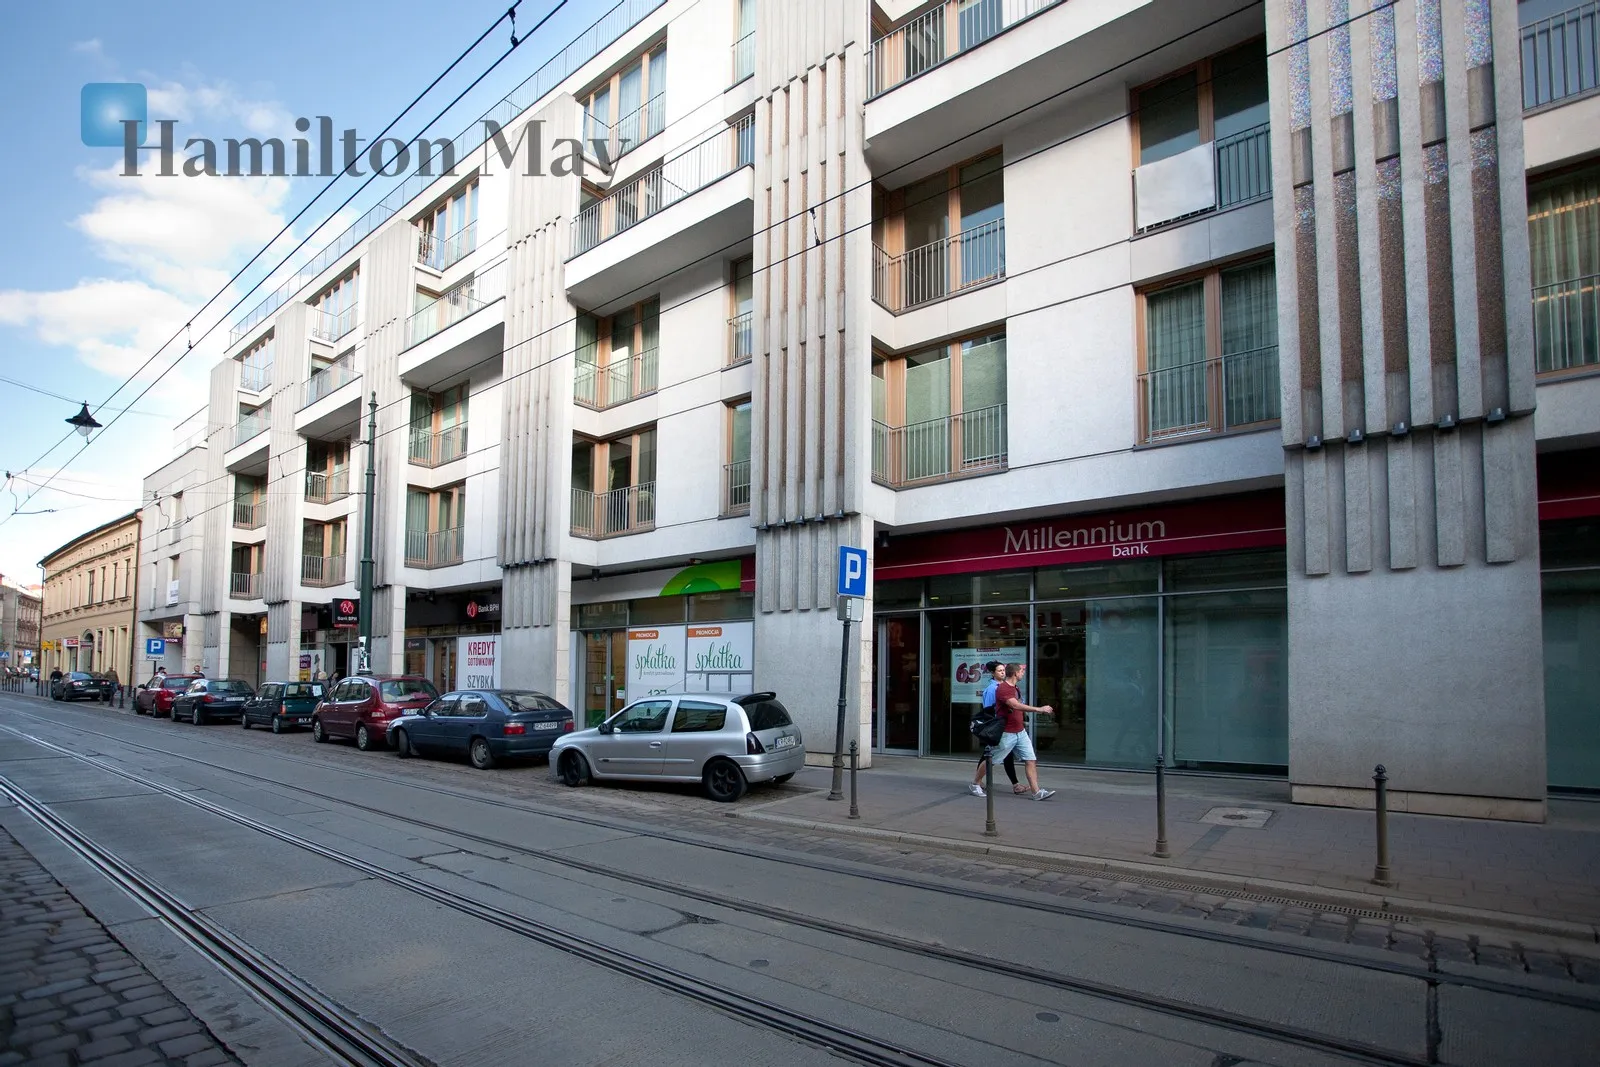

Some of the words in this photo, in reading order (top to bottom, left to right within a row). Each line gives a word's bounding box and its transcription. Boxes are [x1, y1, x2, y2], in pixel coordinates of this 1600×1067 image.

[1004, 520, 1165, 553] Millennium
[1112, 542, 1149, 557] bank
[845, 552, 861, 589] P
[478, 605, 489, 613] Bank
[489, 603, 500, 612] BPH
[150, 640, 162, 652] P
[467, 641, 496, 656] KREDYT
[467, 657, 495, 666] GOTÓWKOWY
[467, 675, 494, 689] SZYBKA
